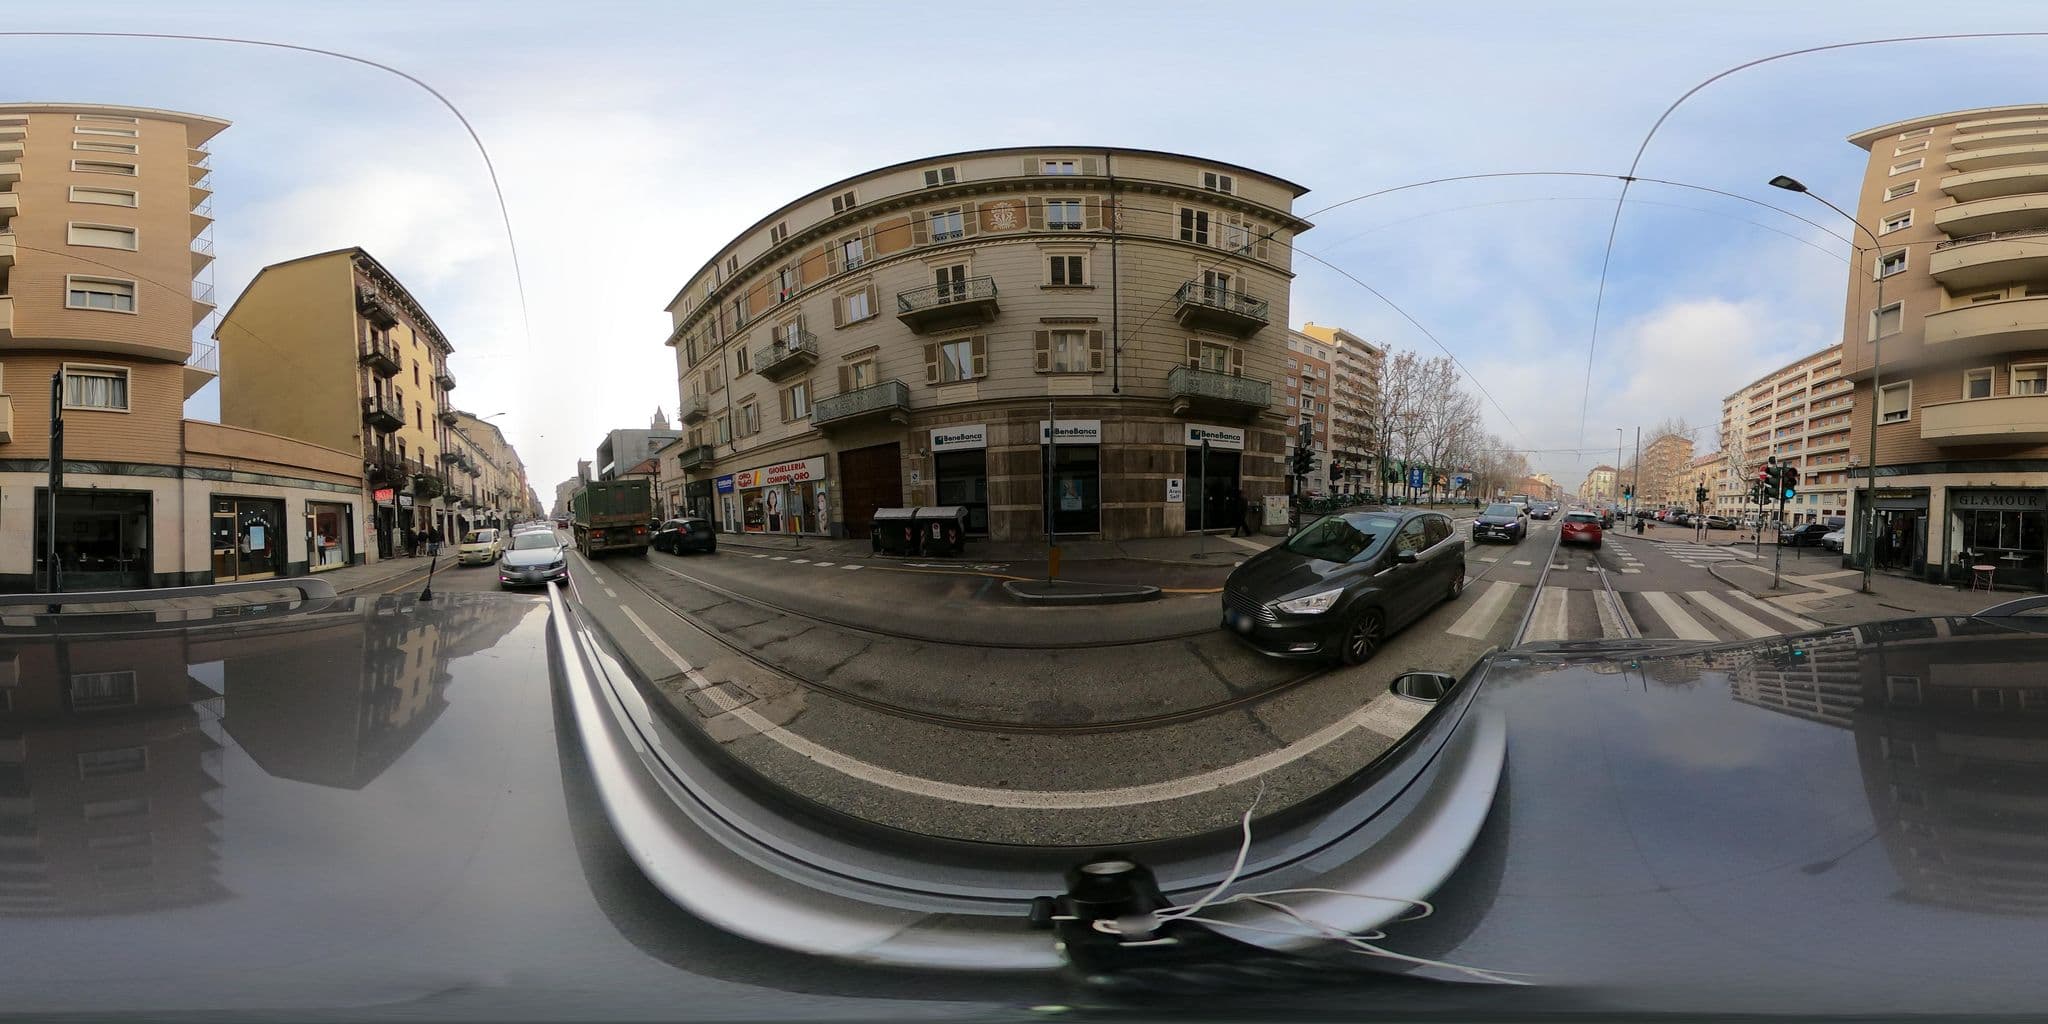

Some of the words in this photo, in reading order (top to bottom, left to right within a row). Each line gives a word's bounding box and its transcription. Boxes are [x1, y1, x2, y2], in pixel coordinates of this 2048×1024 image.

[944, 433, 982, 442] BeneBanca
[1201, 430, 1241, 441] BeneBanca
[768, 462, 806, 474] GIOIELLERIA
[794, 471, 810, 480] ORO
[1959, 495, 2038, 506] GLAMOUR
